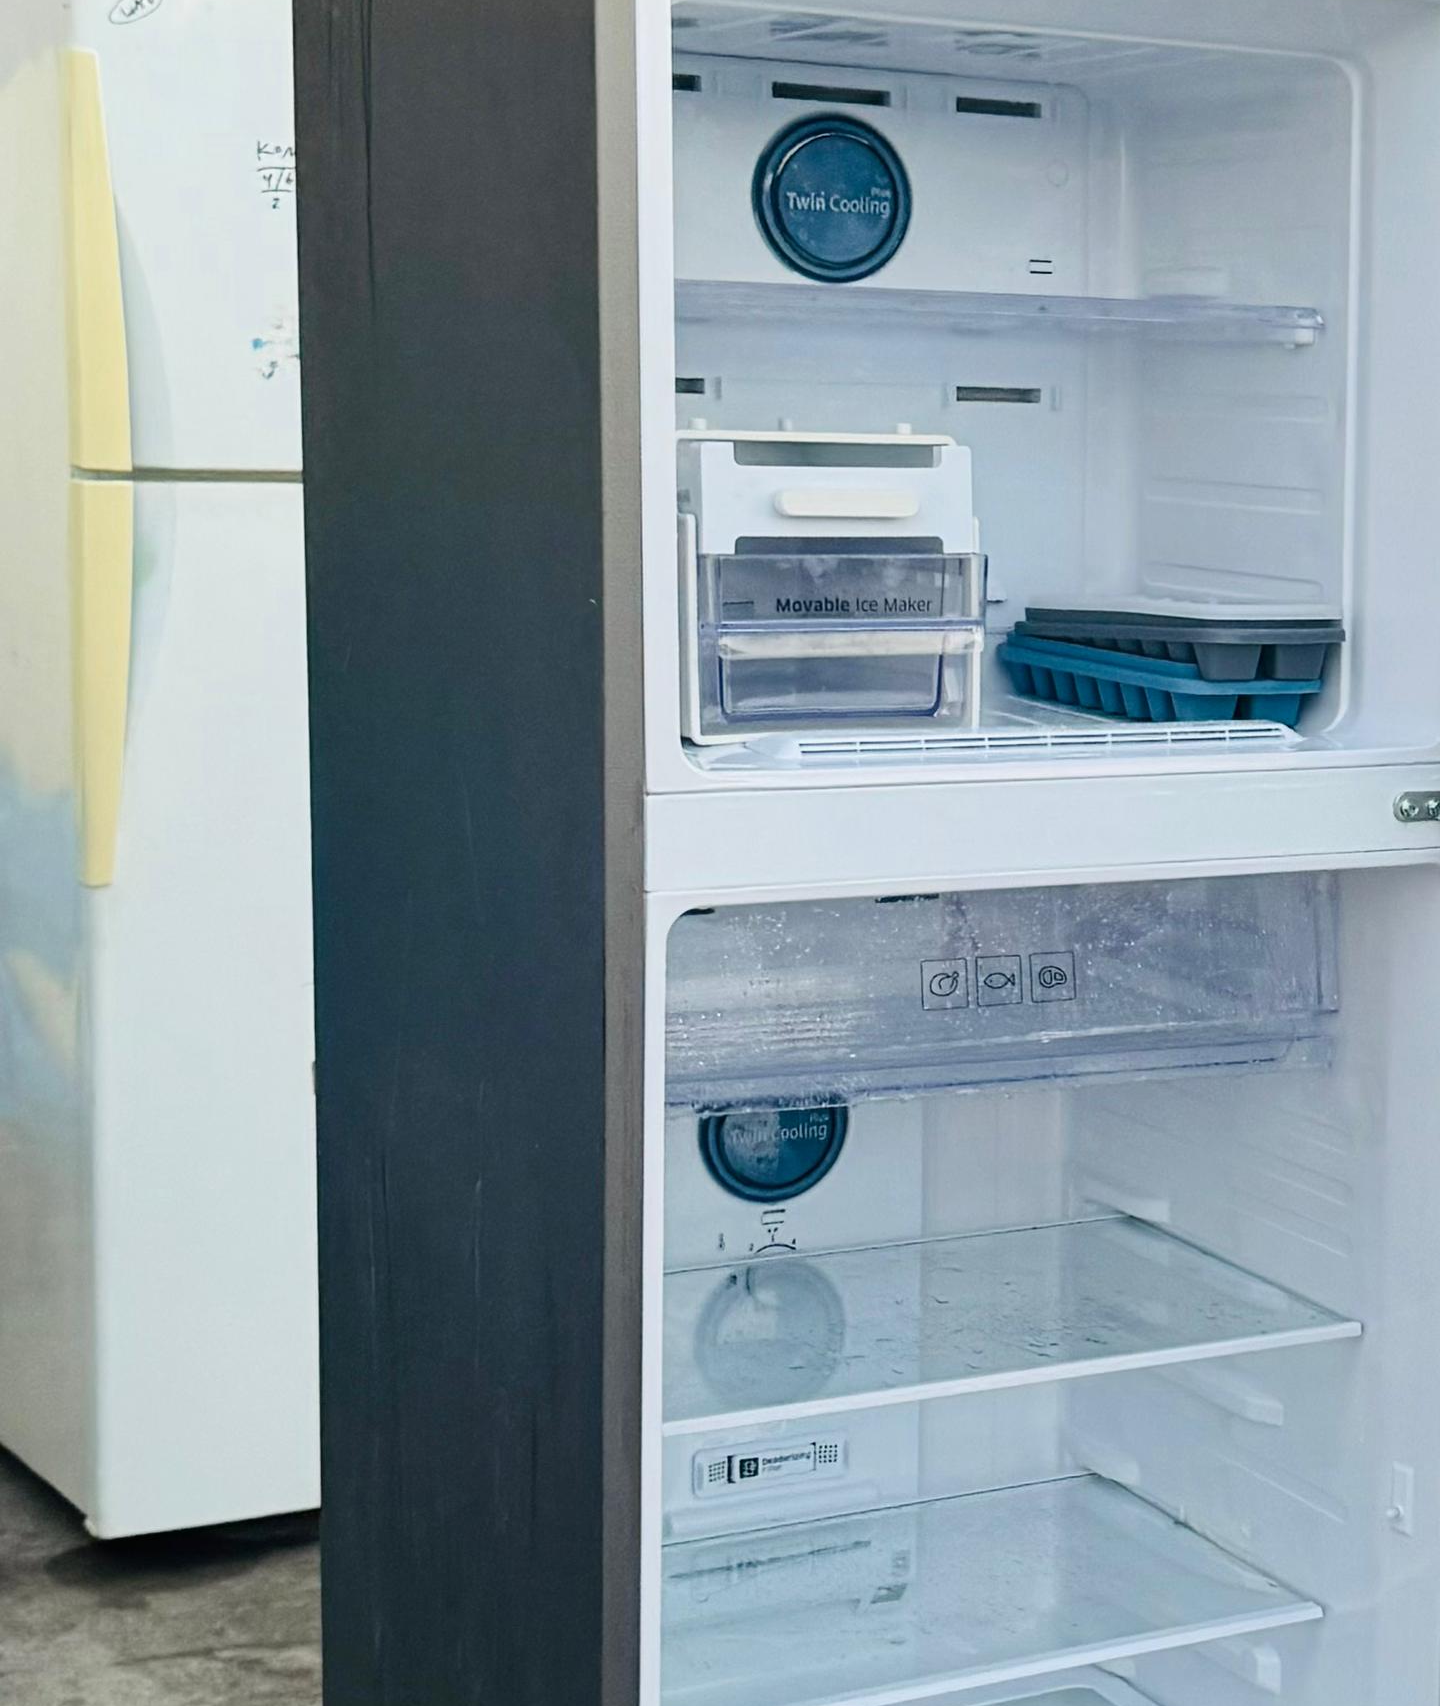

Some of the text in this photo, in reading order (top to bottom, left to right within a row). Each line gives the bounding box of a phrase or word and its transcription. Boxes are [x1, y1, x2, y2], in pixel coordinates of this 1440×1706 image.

[786, 191, 890, 219] Twin Cooling
[776, 597, 932, 613] Movable Ice Maker
